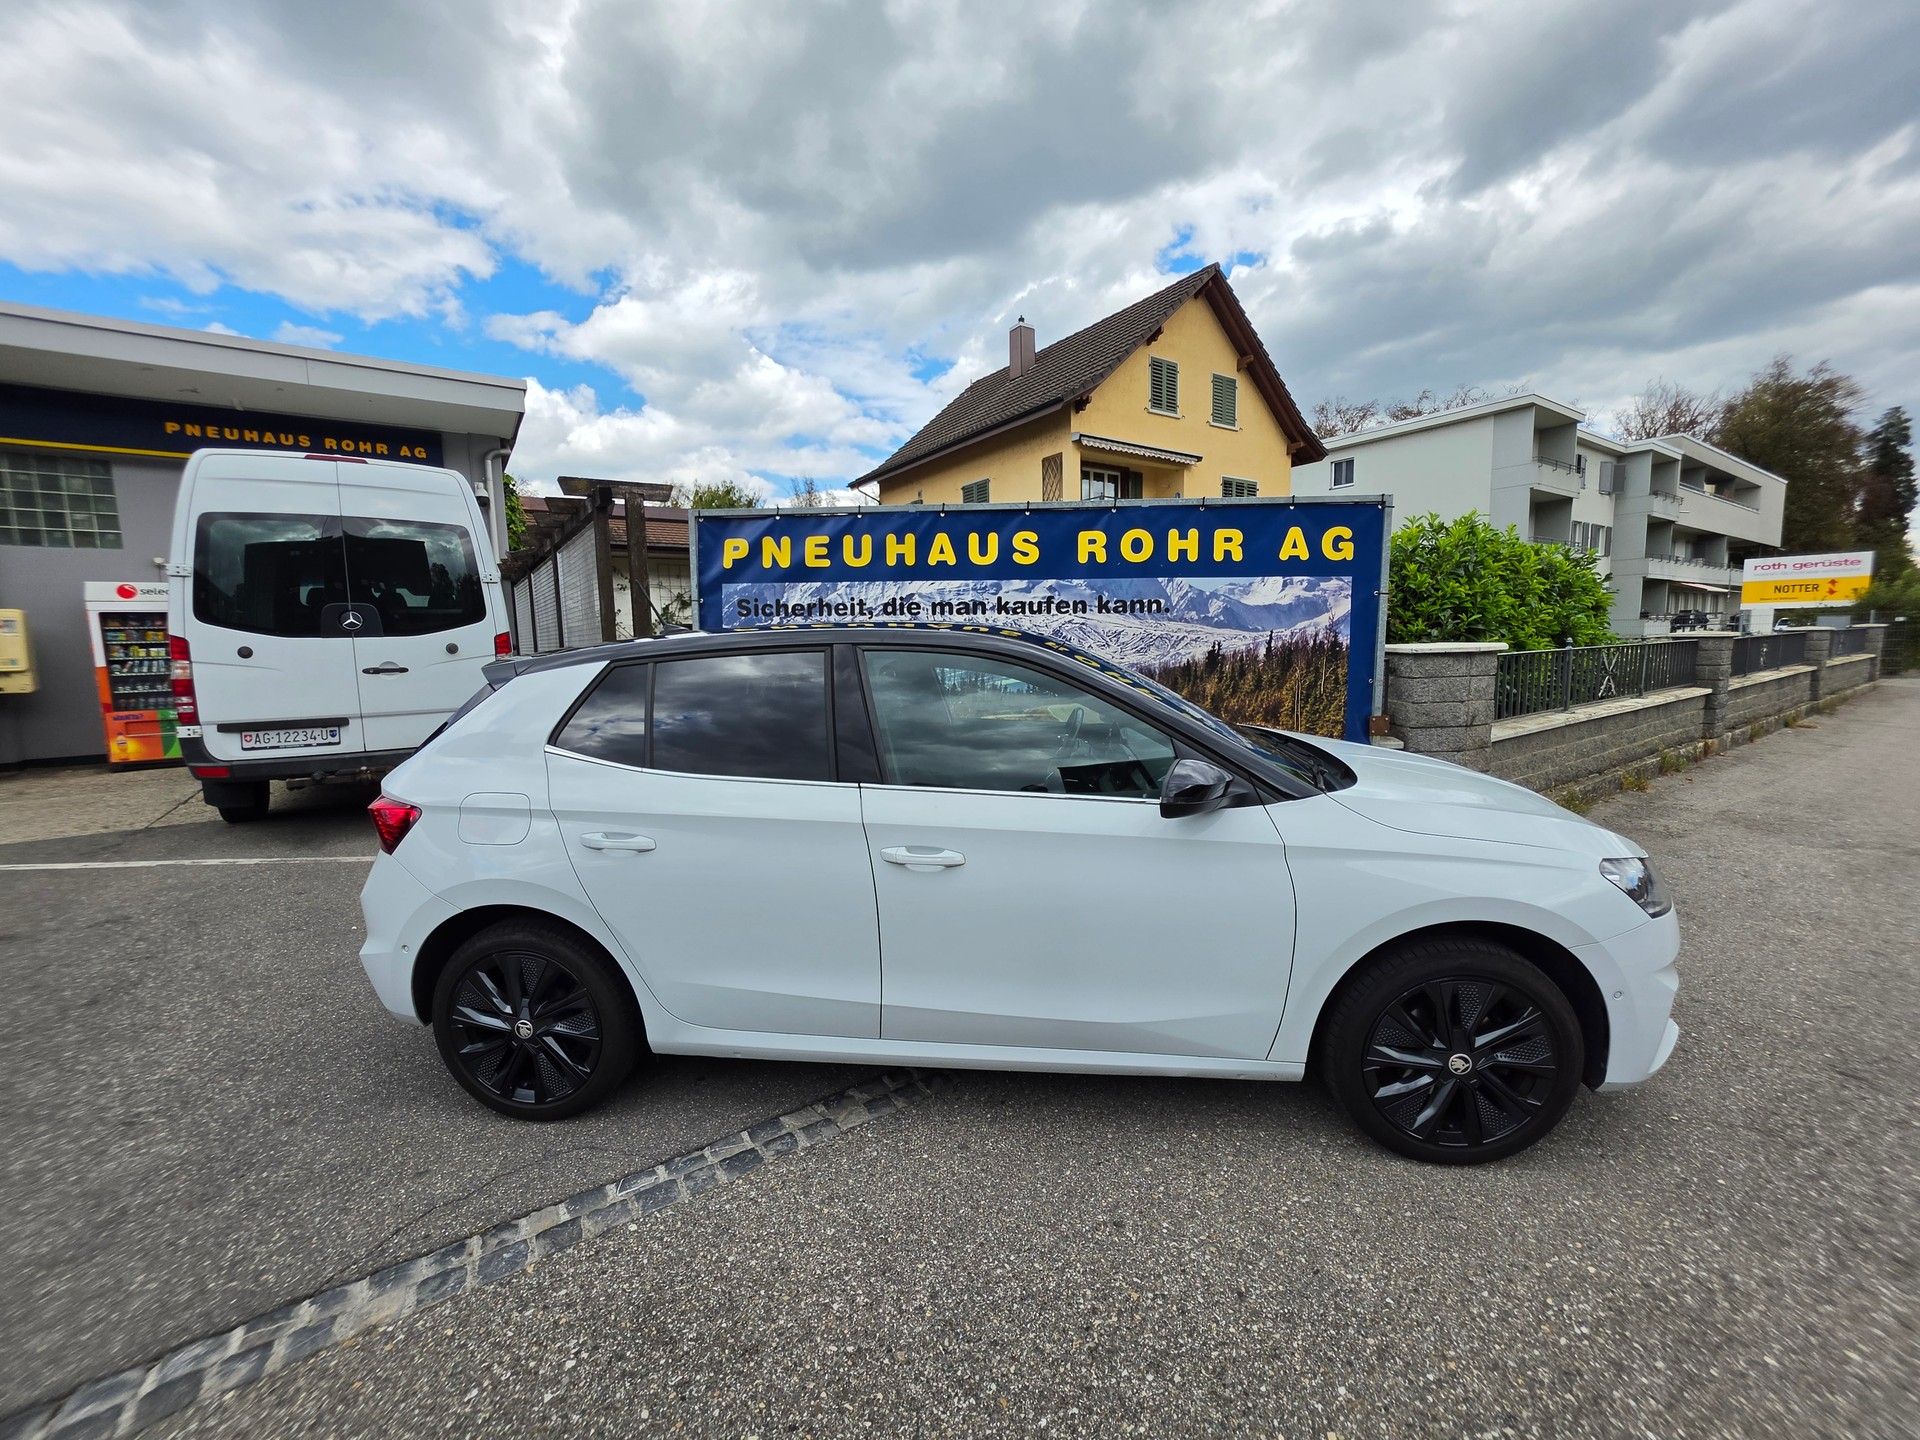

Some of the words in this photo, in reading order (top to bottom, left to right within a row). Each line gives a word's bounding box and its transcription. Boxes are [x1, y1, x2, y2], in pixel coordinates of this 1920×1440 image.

[165, 422, 311, 447] PNEUHAUS
[325, 437, 388, 455] ROHR
[400, 446, 427, 459] AG
[722, 530, 1041, 569] PNEUHAUS
[1077, 528, 1244, 564] ROHR
[1278, 526, 1355, 561] AG
[1754, 562, 1787, 571] roth
[1792, 558, 1862, 571] gerüste
[1774, 583, 1820, 594] NOTTER
[737, 597, 875, 620] Sicherheit,
[882, 597, 922, 617] die
[931, 602, 989, 617] man
[996, 596, 1088, 616] kaufen
[1097, 595, 1171, 615] kann.
